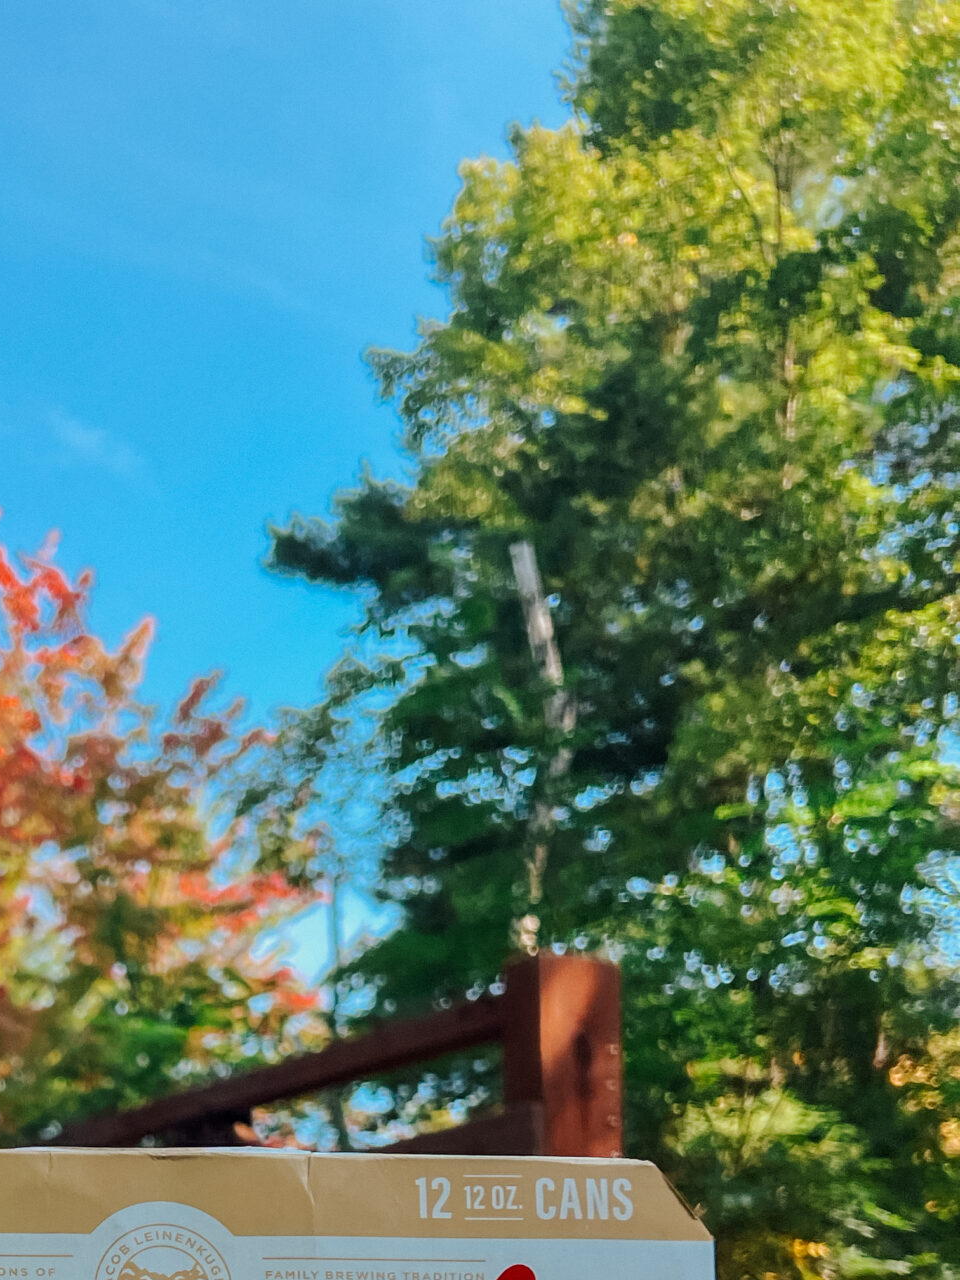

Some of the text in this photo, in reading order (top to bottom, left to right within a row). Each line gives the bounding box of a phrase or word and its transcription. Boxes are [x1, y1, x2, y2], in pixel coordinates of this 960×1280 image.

[415, 1176, 634, 1221] 12 12 OZ. CANS
[35, 1266, 57, 1278] OF
